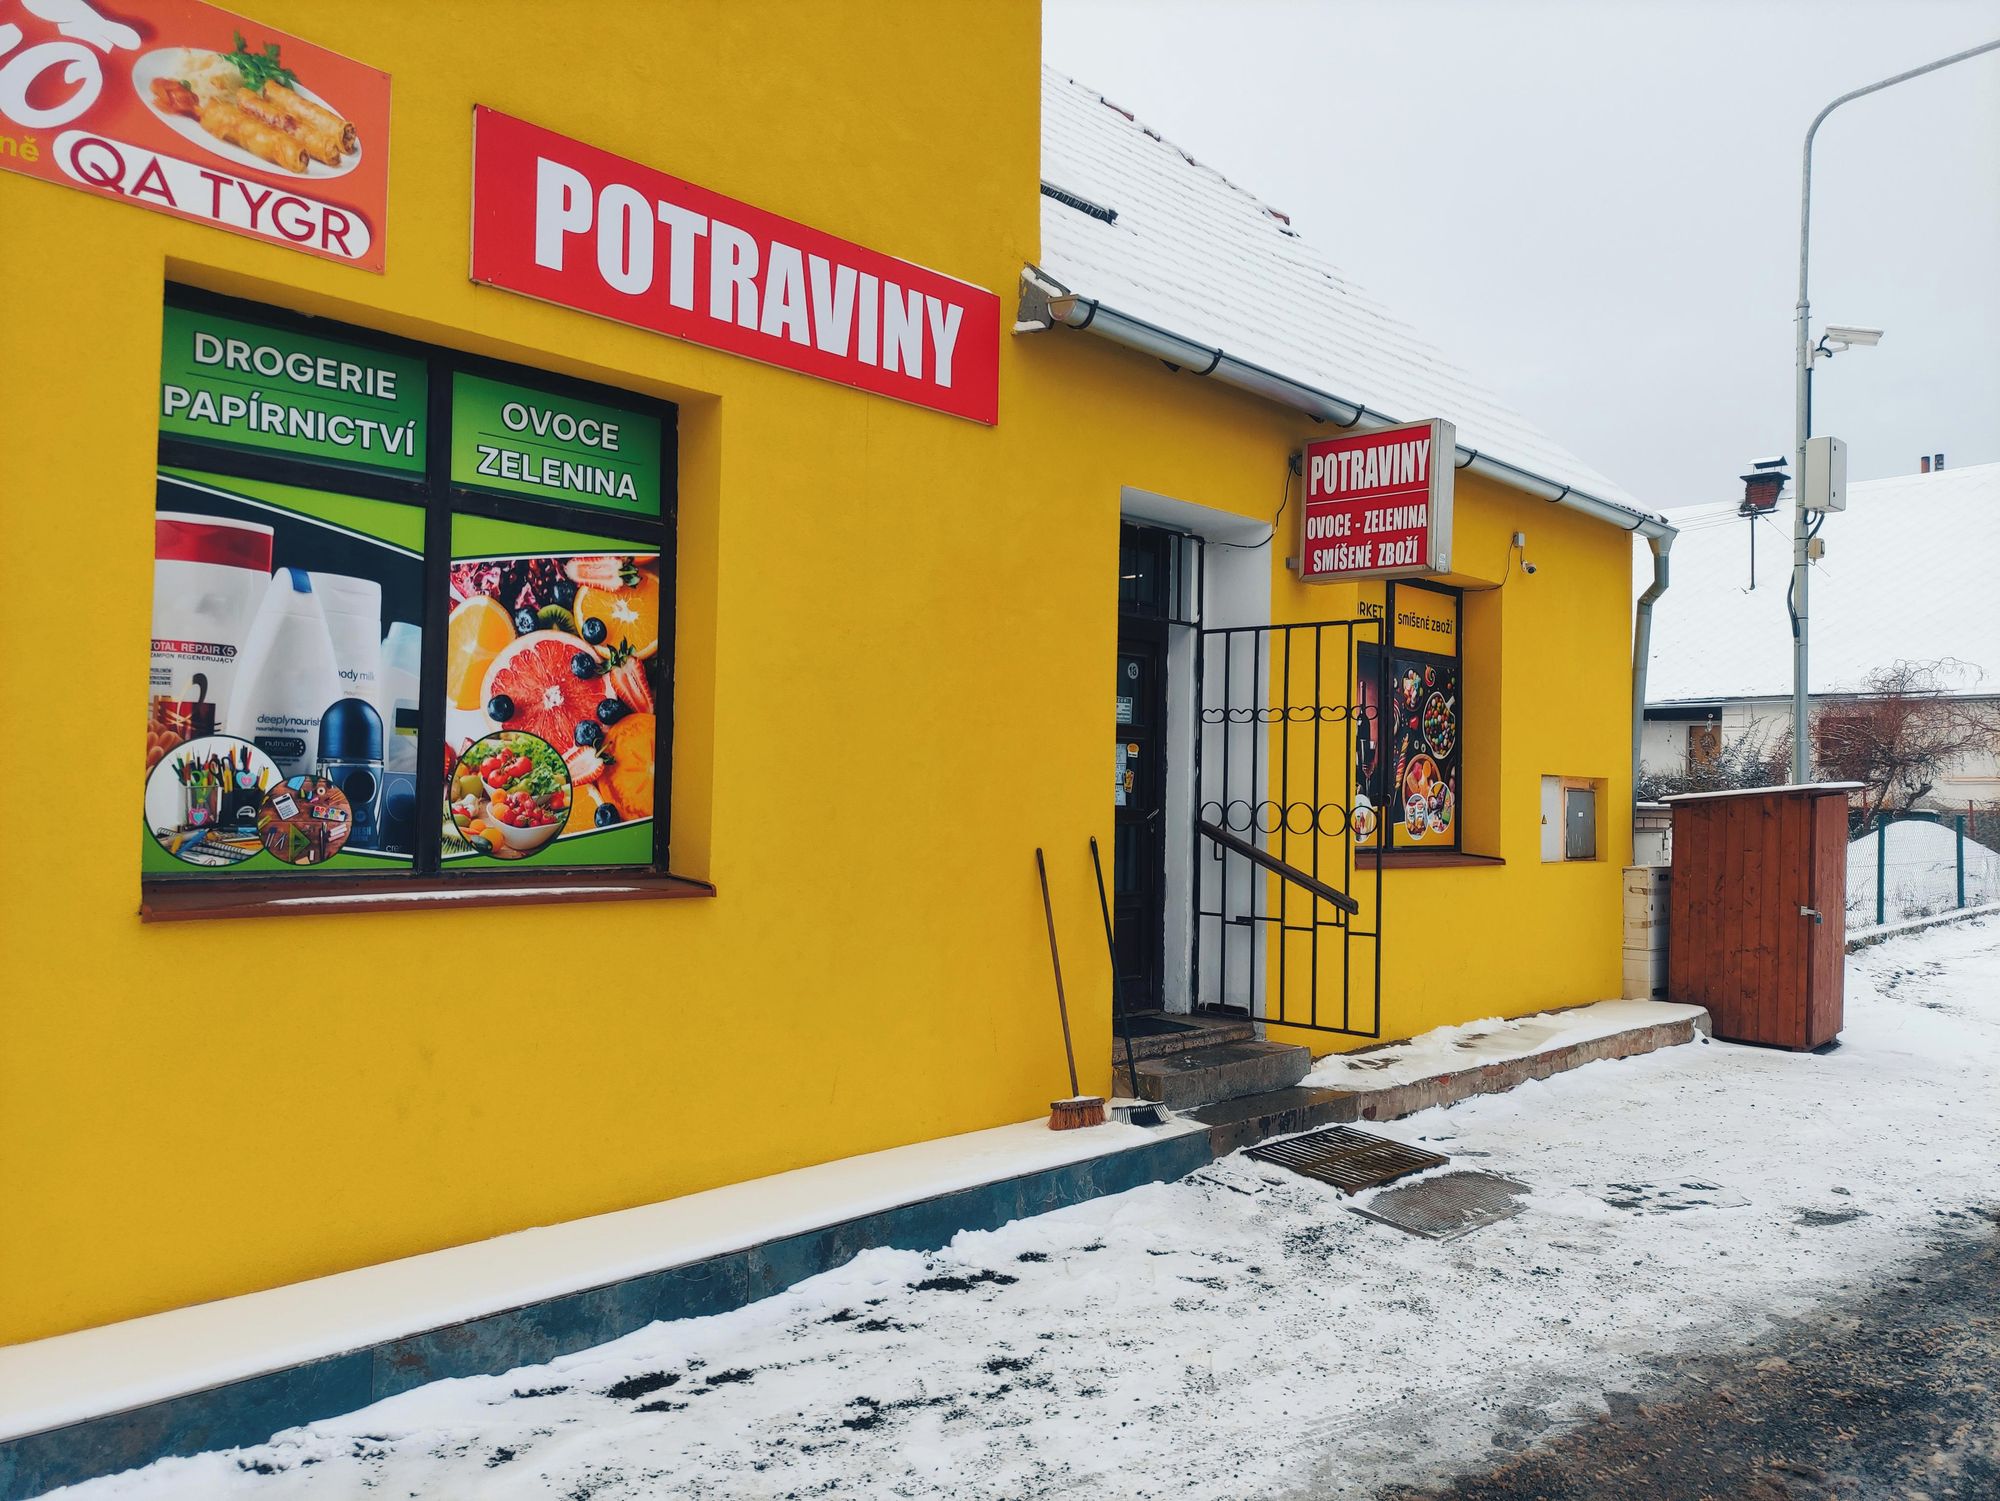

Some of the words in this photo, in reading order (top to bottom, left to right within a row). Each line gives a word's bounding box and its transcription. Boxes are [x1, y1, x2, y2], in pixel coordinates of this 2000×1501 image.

[70, 137, 178, 207] QA
[200, 170, 352, 256] TYGR
[535, 156, 964, 388] POTRAVINY
[195, 331, 397, 400] DROGERIE
[163, 384, 416, 456] PAPÍRNICTVÍ
[501, 402, 619, 452] OVOCE
[477, 444, 637, 501] ZELENINA
[1310, 439, 1430, 495] POTRAVINY
[1307, 513, 1351, 540] OVOCE
[1364, 504, 1427, 534] ZELENINA
[1313, 540, 1371, 572] SMÍŠENÉ
[1377, 536, 1418, 566] ZBOŽÍ
[1357, 602, 1383, 619] RKET
[181, 643, 221, 655] REPAIR
[338, 668, 358, 682] ody
